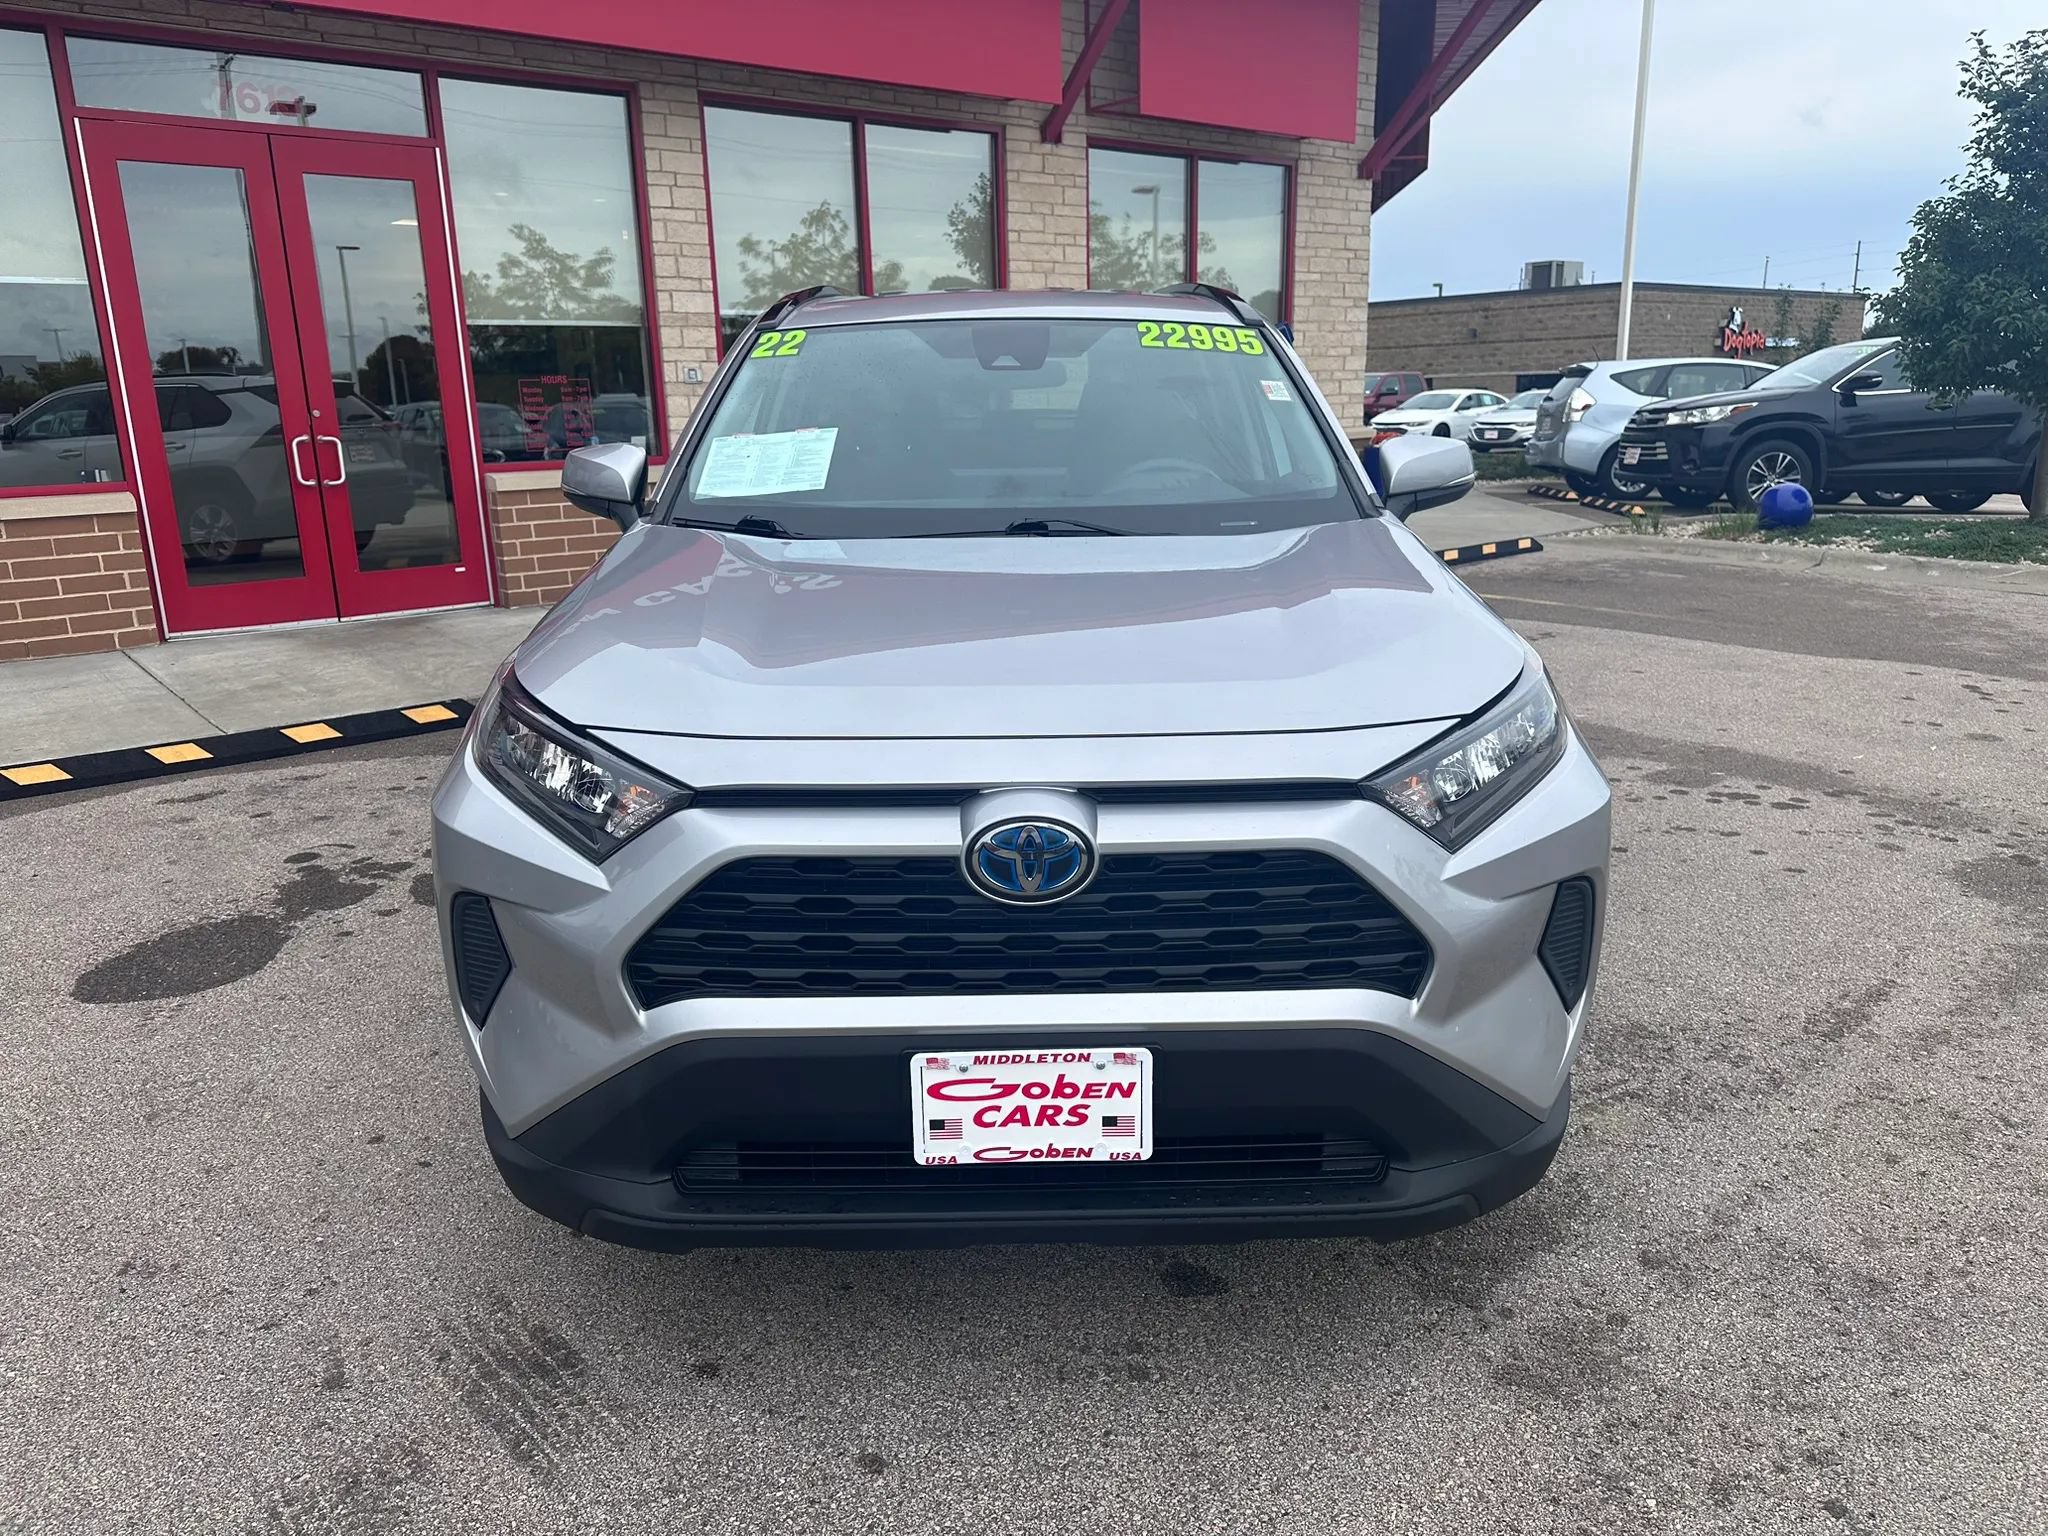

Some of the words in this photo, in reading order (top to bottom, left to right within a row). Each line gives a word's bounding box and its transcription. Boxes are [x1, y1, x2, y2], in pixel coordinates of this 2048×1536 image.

[751, 330, 807, 358] 22
[1137, 321, 1264, 355] 22995
[1723, 321, 1766, 360] Dogtopia
[541, 375, 568, 385] HOURS
[973, 1052, 1092, 1065] MIDDLETON
[973, 1104, 1092, 1129] CARS
[925, 1155, 958, 1165] USA
[1109, 1151, 1142, 1161] USA
